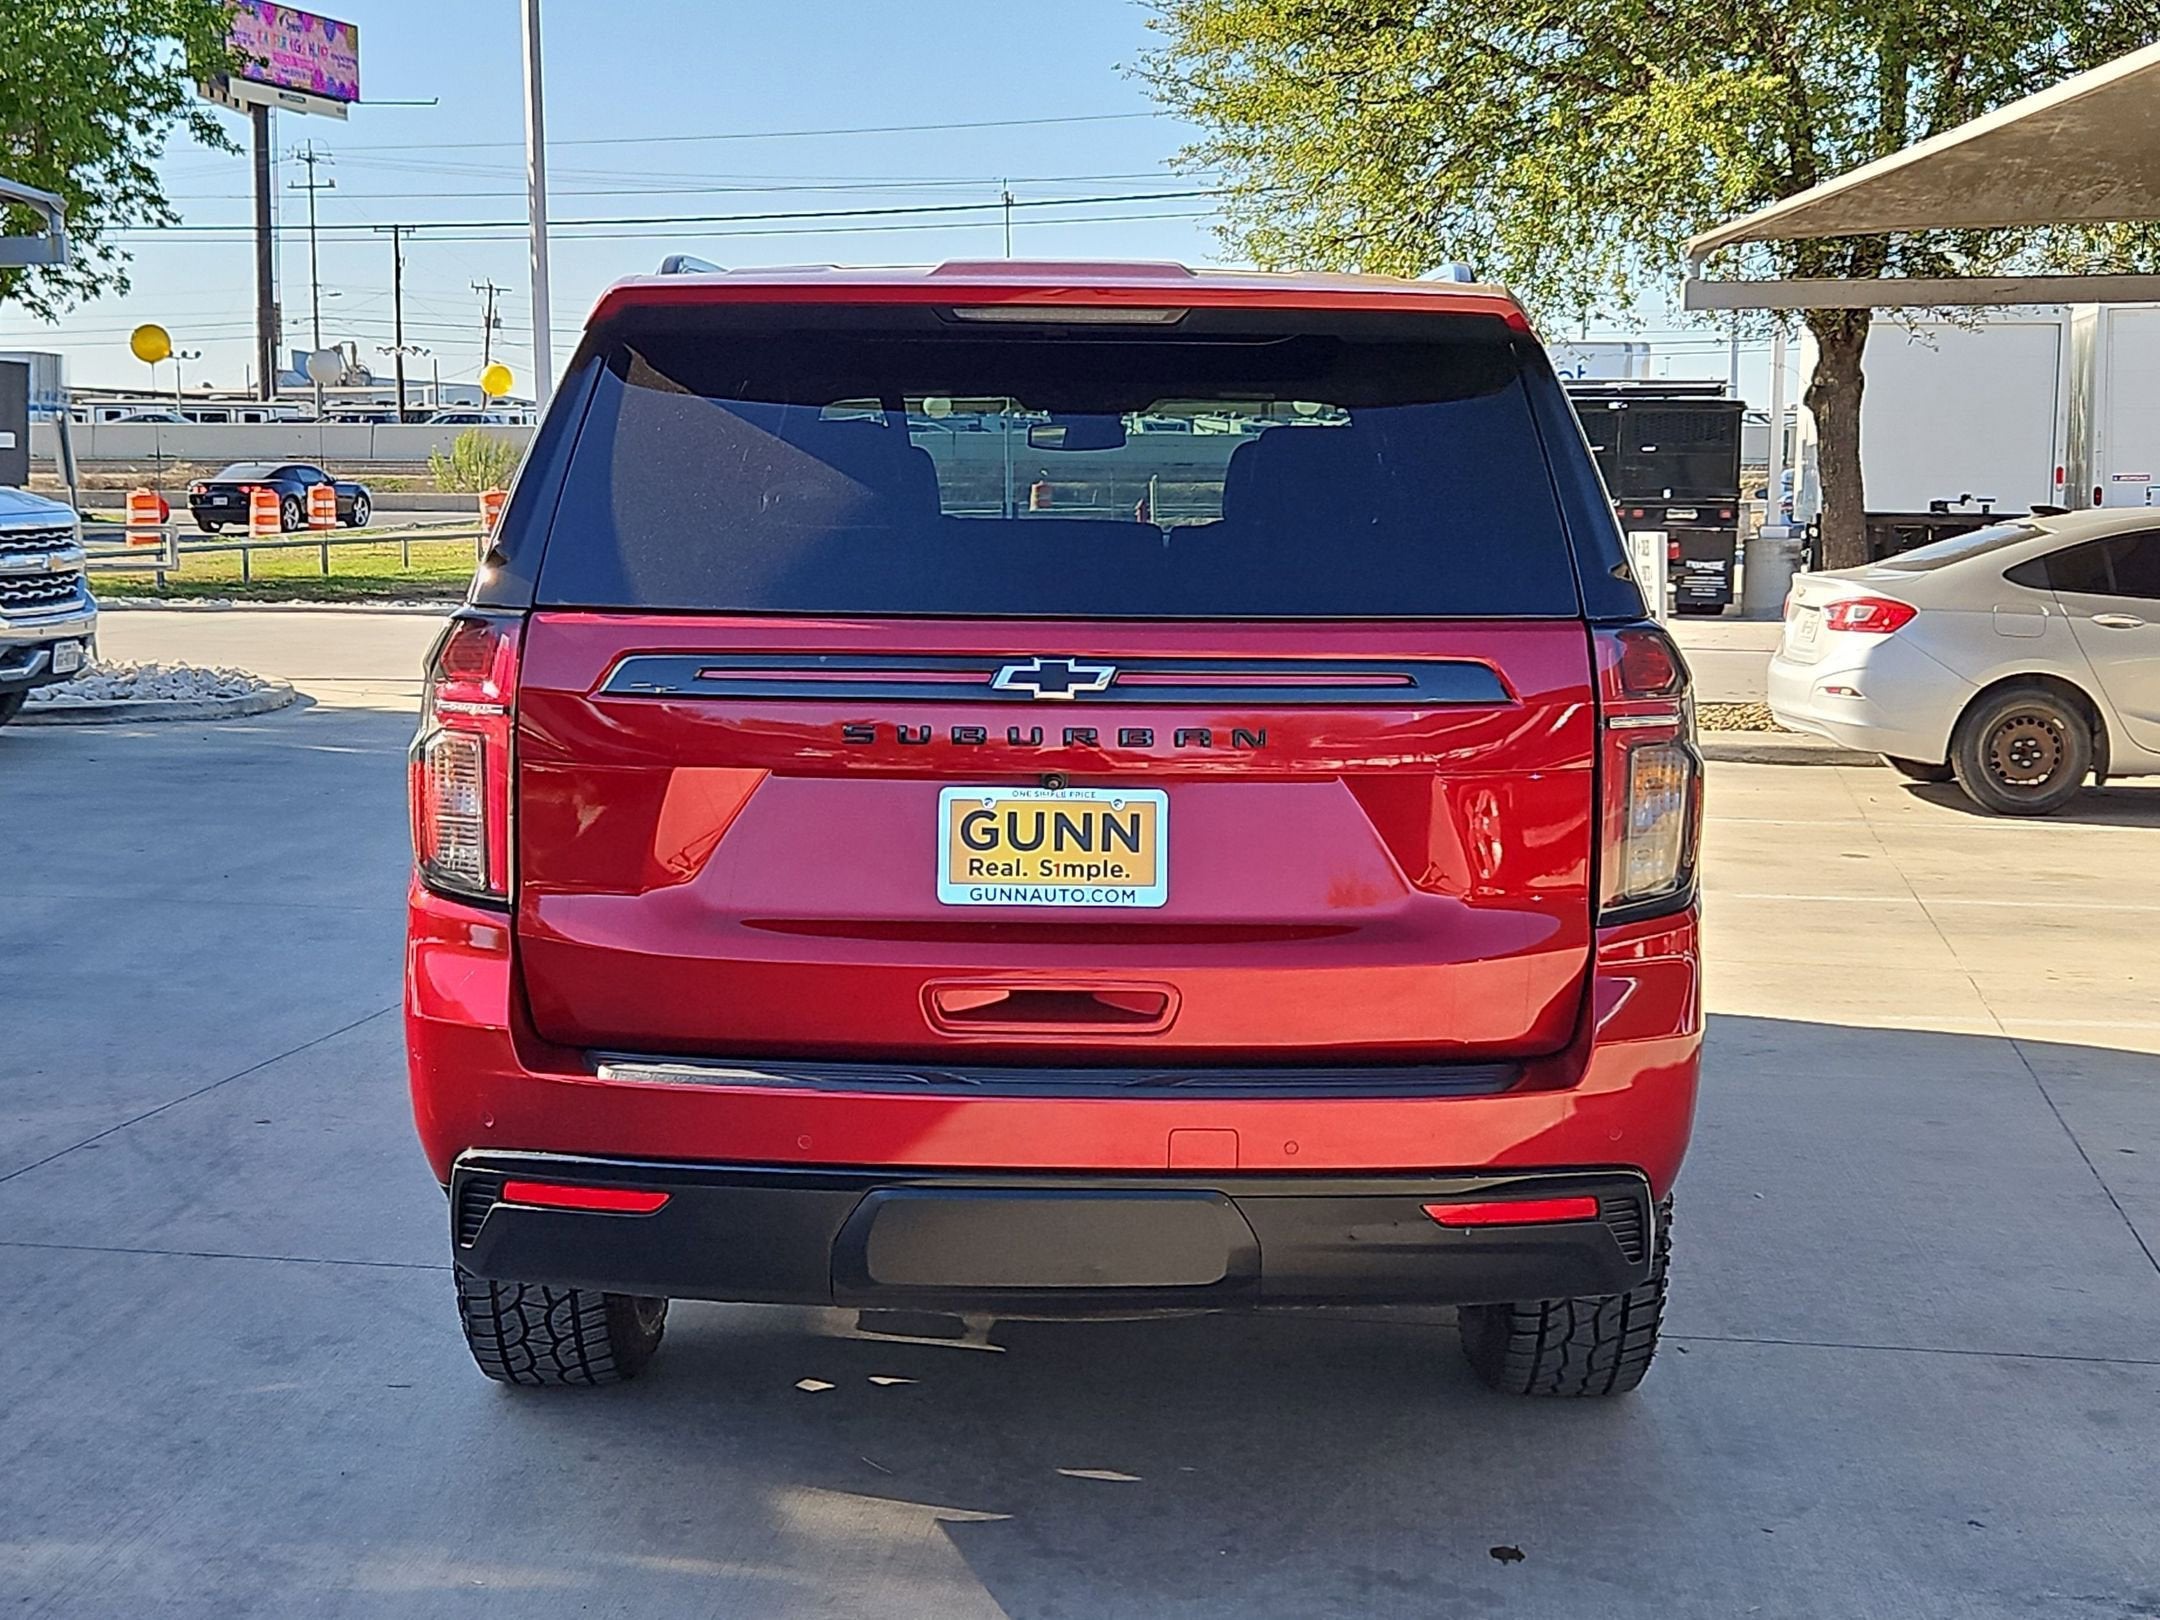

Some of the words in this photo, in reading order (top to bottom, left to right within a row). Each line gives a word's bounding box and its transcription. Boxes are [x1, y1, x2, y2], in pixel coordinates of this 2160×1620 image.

[841, 725, 1268, 749] SUBURBAN
[1012, 790, 1031, 798] ONE
[1069, 791, 1096, 799] PRICE
[960, 810, 1141, 853] GUNN
[968, 858, 1029, 877] Real.
[969, 887, 1136, 904] GUNNAUTO.COM
